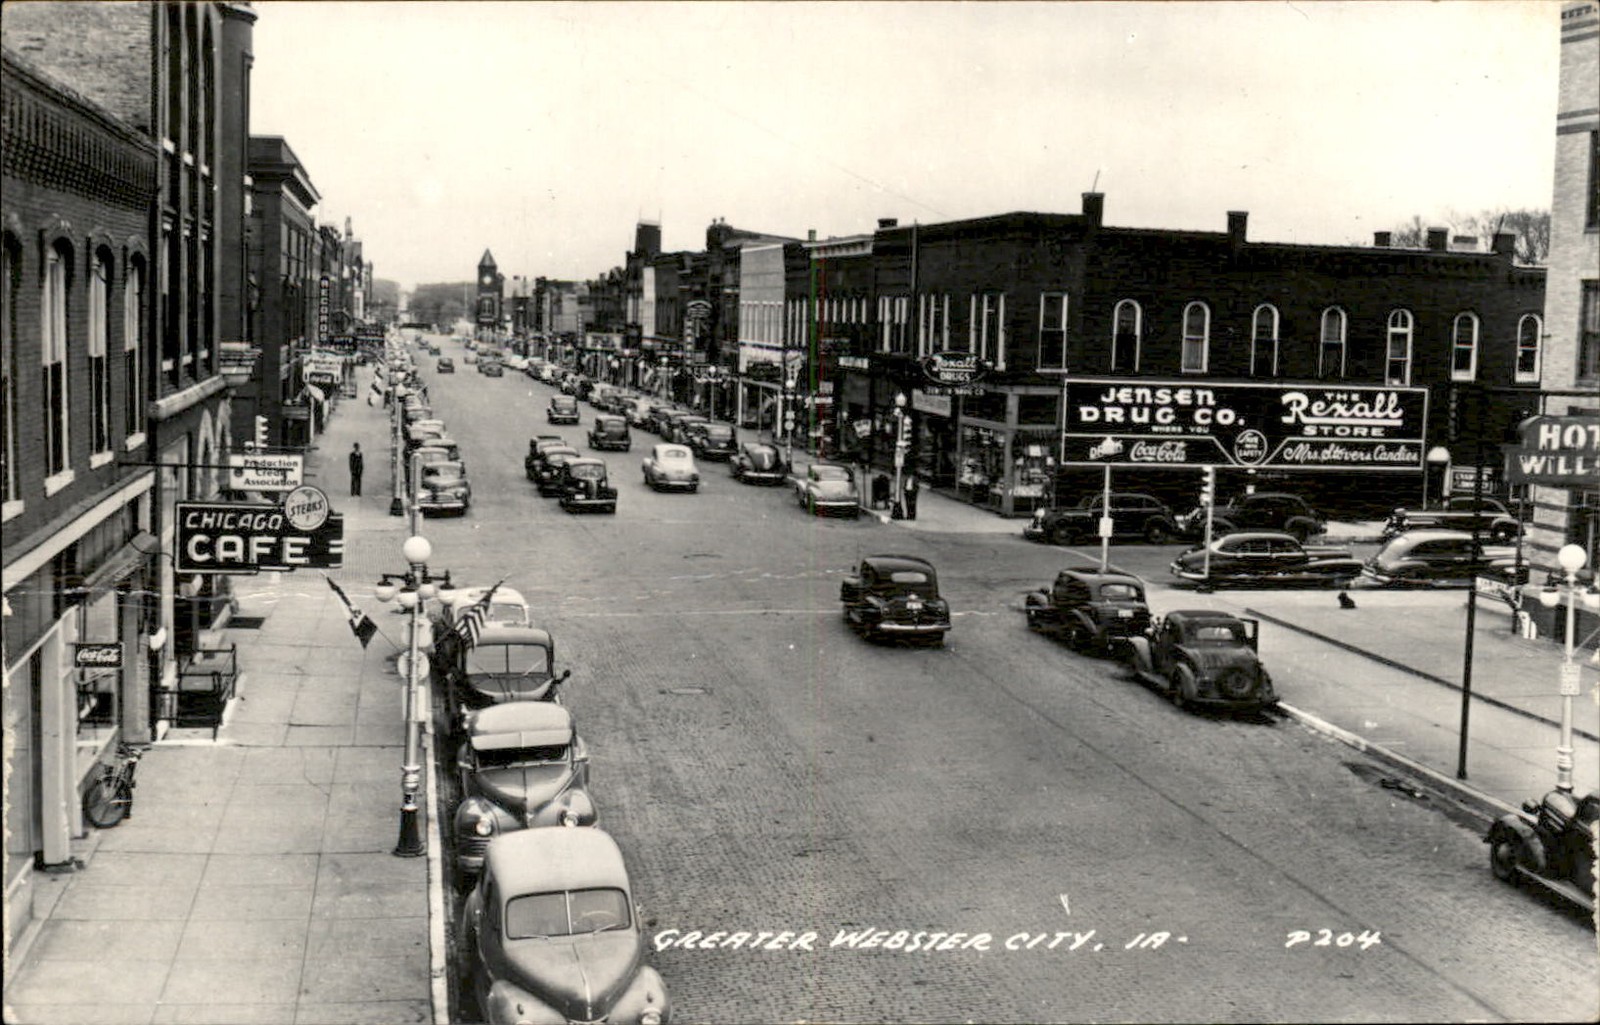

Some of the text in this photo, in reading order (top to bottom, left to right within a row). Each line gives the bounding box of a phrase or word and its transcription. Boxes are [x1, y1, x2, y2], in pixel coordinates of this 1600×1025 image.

[940, 372, 970, 381] DRUGS
[1324, 393, 1360, 402] THE
[1281, 391, 1404, 426] Rexall
[1079, 406, 1245, 426] DRUG CO.
[1189, 426, 1210, 434] YOU
[1303, 425, 1385, 437] STORE
[244, 459, 298, 468] Production
[186, 512, 283, 530] CHICAGO
[187, 534, 311, 564] CAFE
